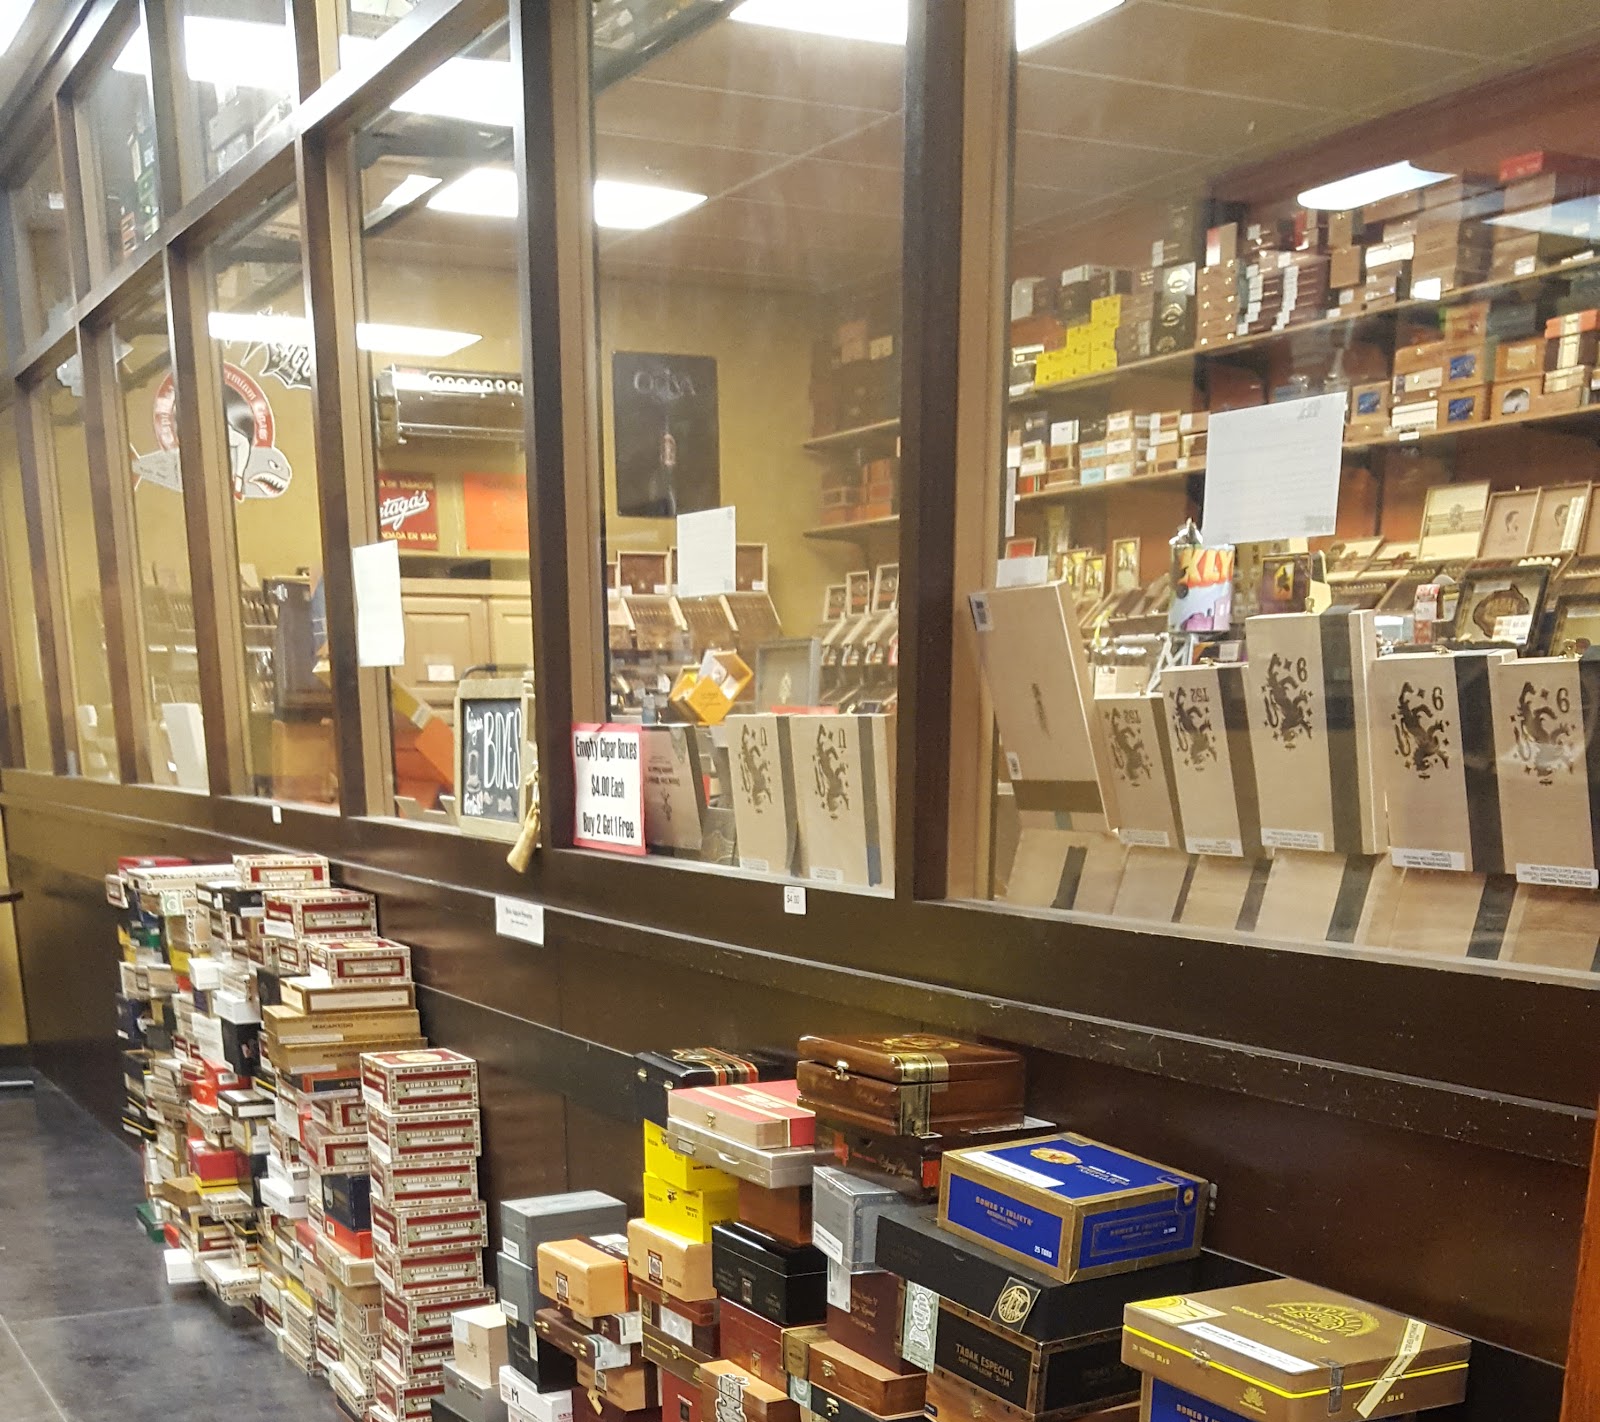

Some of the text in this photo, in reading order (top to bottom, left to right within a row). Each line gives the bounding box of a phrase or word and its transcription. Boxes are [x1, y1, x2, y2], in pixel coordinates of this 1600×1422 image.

[483, 708, 522, 790] BOXES
[575, 736, 637, 763] Empty Cigar Boxes
[591, 774, 625, 799] $4.00 Each
[583, 812, 595, 837] Buy
[596, 814, 601, 834] 2
[603, 814, 613, 836] Get
[618, 816, 635, 839] Free
[975, 1195, 998, 1212] ROMEO
[1005, 1207, 1033, 1226] JULIETA
[955, 1343, 979, 1363] TABAK
[980, 1354, 1014, 1382] ESPECIAL
[1176, 1403, 1202, 1421] ROMEO
